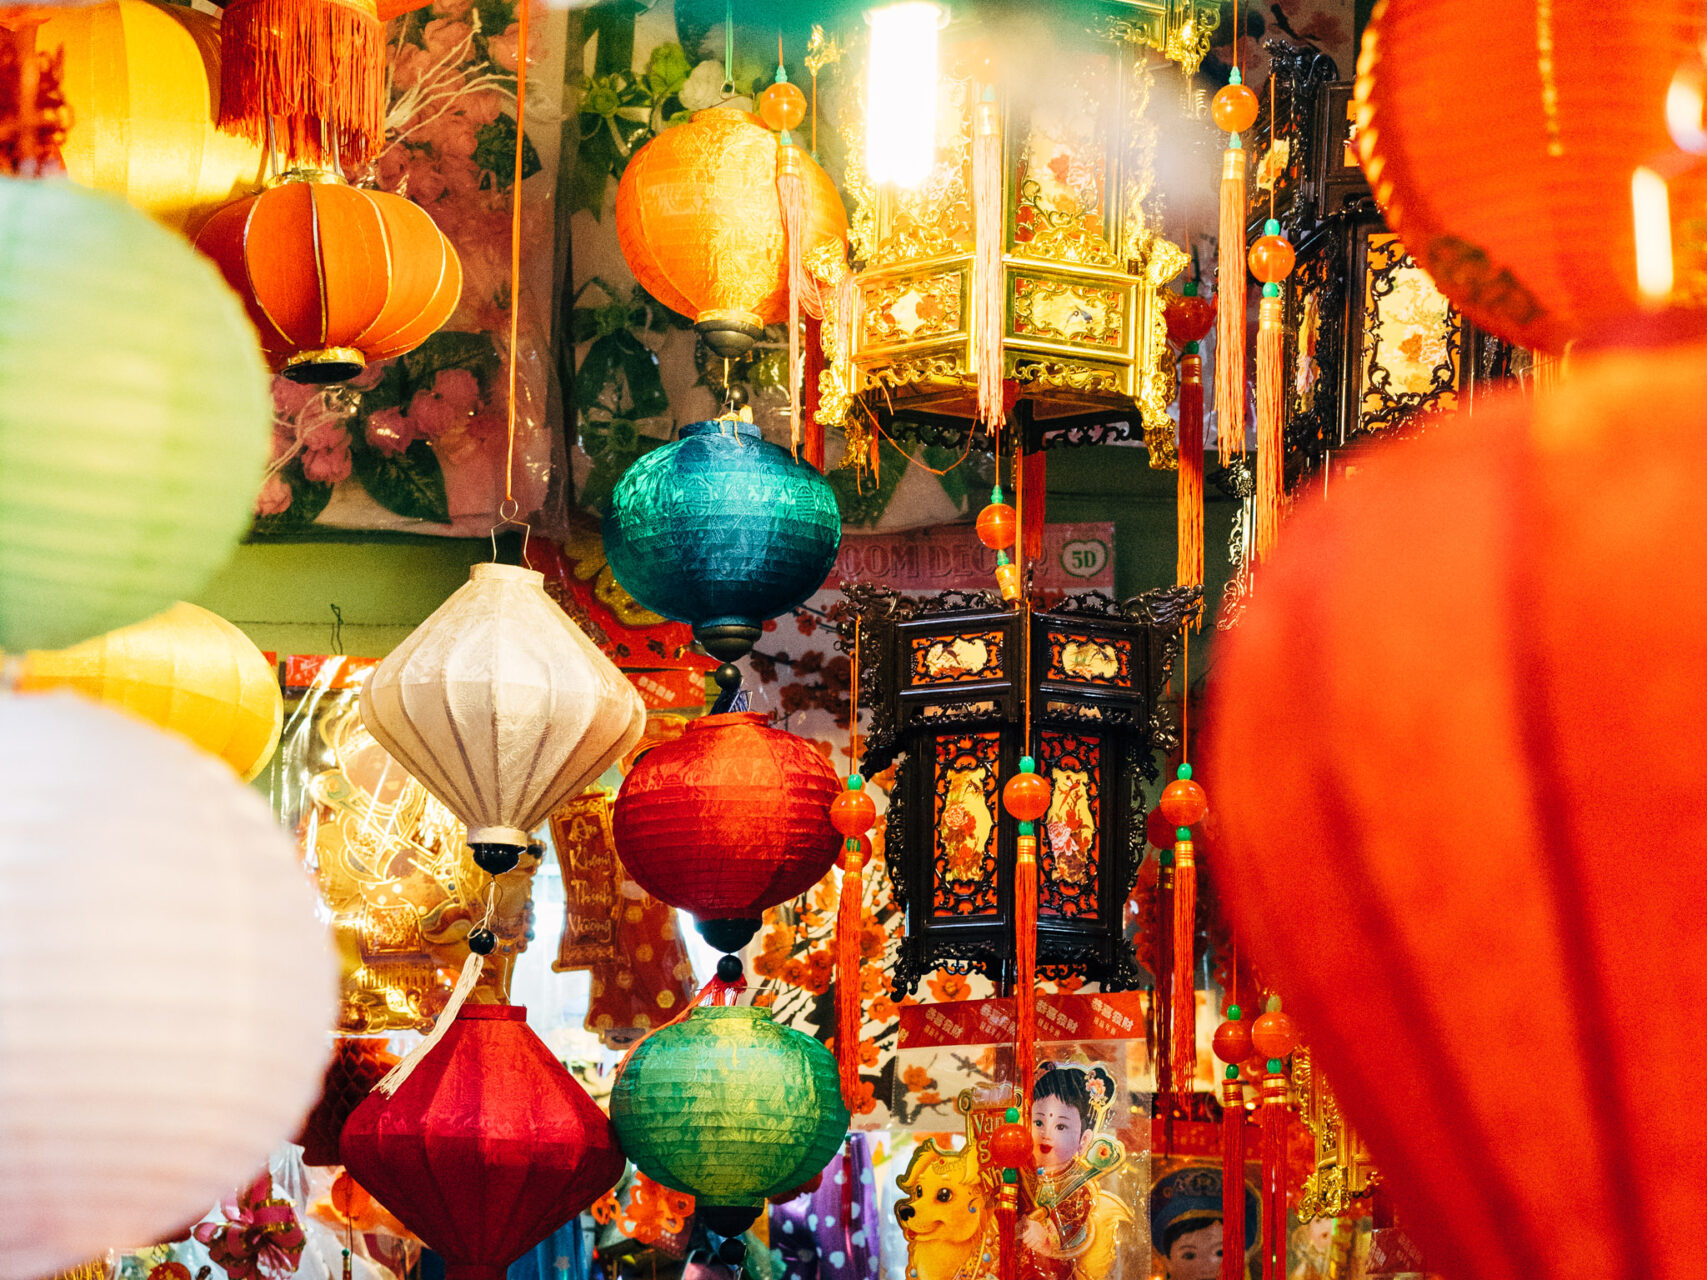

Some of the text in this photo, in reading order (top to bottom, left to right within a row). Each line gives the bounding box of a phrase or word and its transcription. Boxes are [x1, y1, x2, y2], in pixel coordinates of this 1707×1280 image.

[831, 543, 919, 578] OOM
[1071, 549, 1096, 569] 5D
[978, 1139, 992, 1164] S
